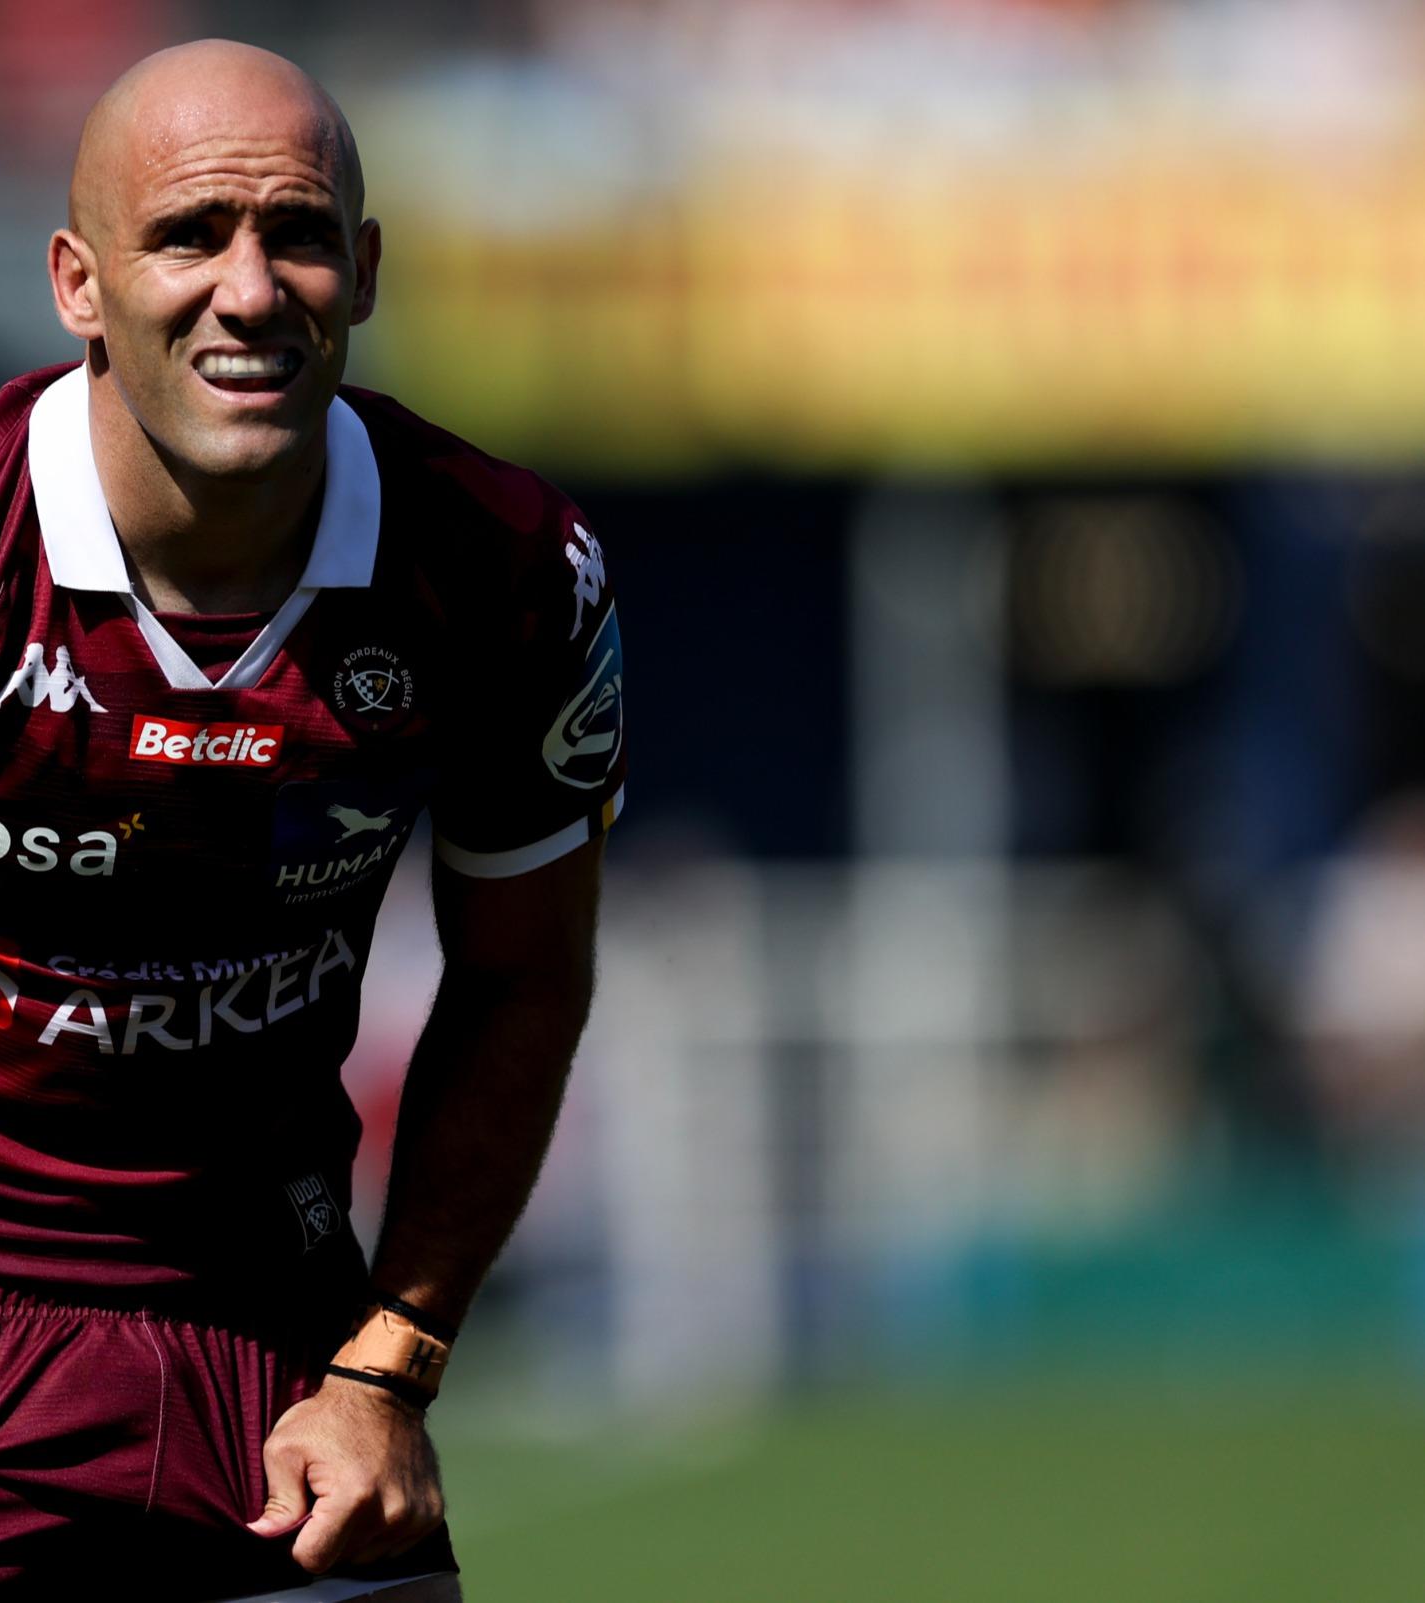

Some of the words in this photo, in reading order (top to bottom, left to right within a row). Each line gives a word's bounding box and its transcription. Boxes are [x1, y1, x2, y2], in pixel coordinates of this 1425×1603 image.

[333, 671, 346, 709] UNION
[343, 646, 400, 667] BORDEAUX
[133, 721, 279, 764] Betclic
[36, 927, 358, 1056] ARKEA
[46, 953, 185, 982] Crédit
